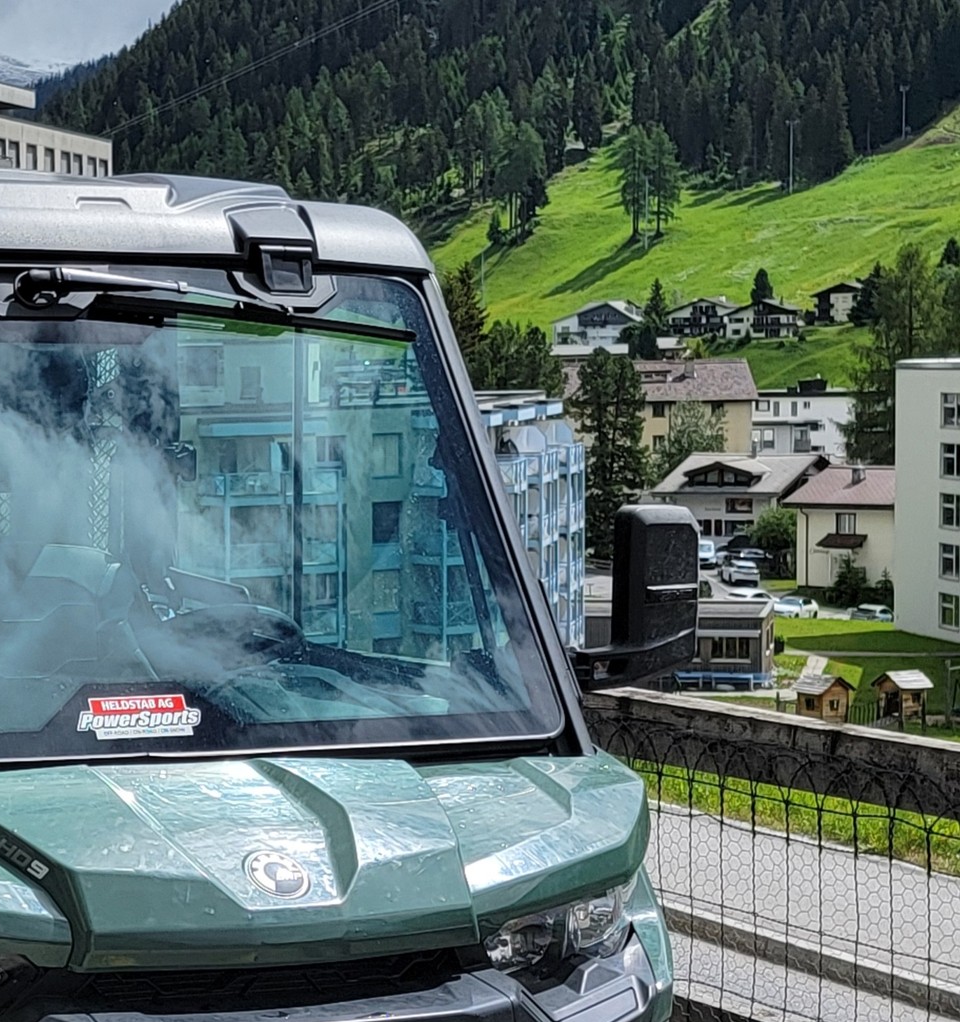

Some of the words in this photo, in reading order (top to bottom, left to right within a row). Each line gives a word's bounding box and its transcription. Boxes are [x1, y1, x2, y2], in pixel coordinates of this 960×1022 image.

[101, 699, 156, 711] HELDSTAB
[158, 698, 174, 708] AG
[78, 709, 200, 730] PowerSports
